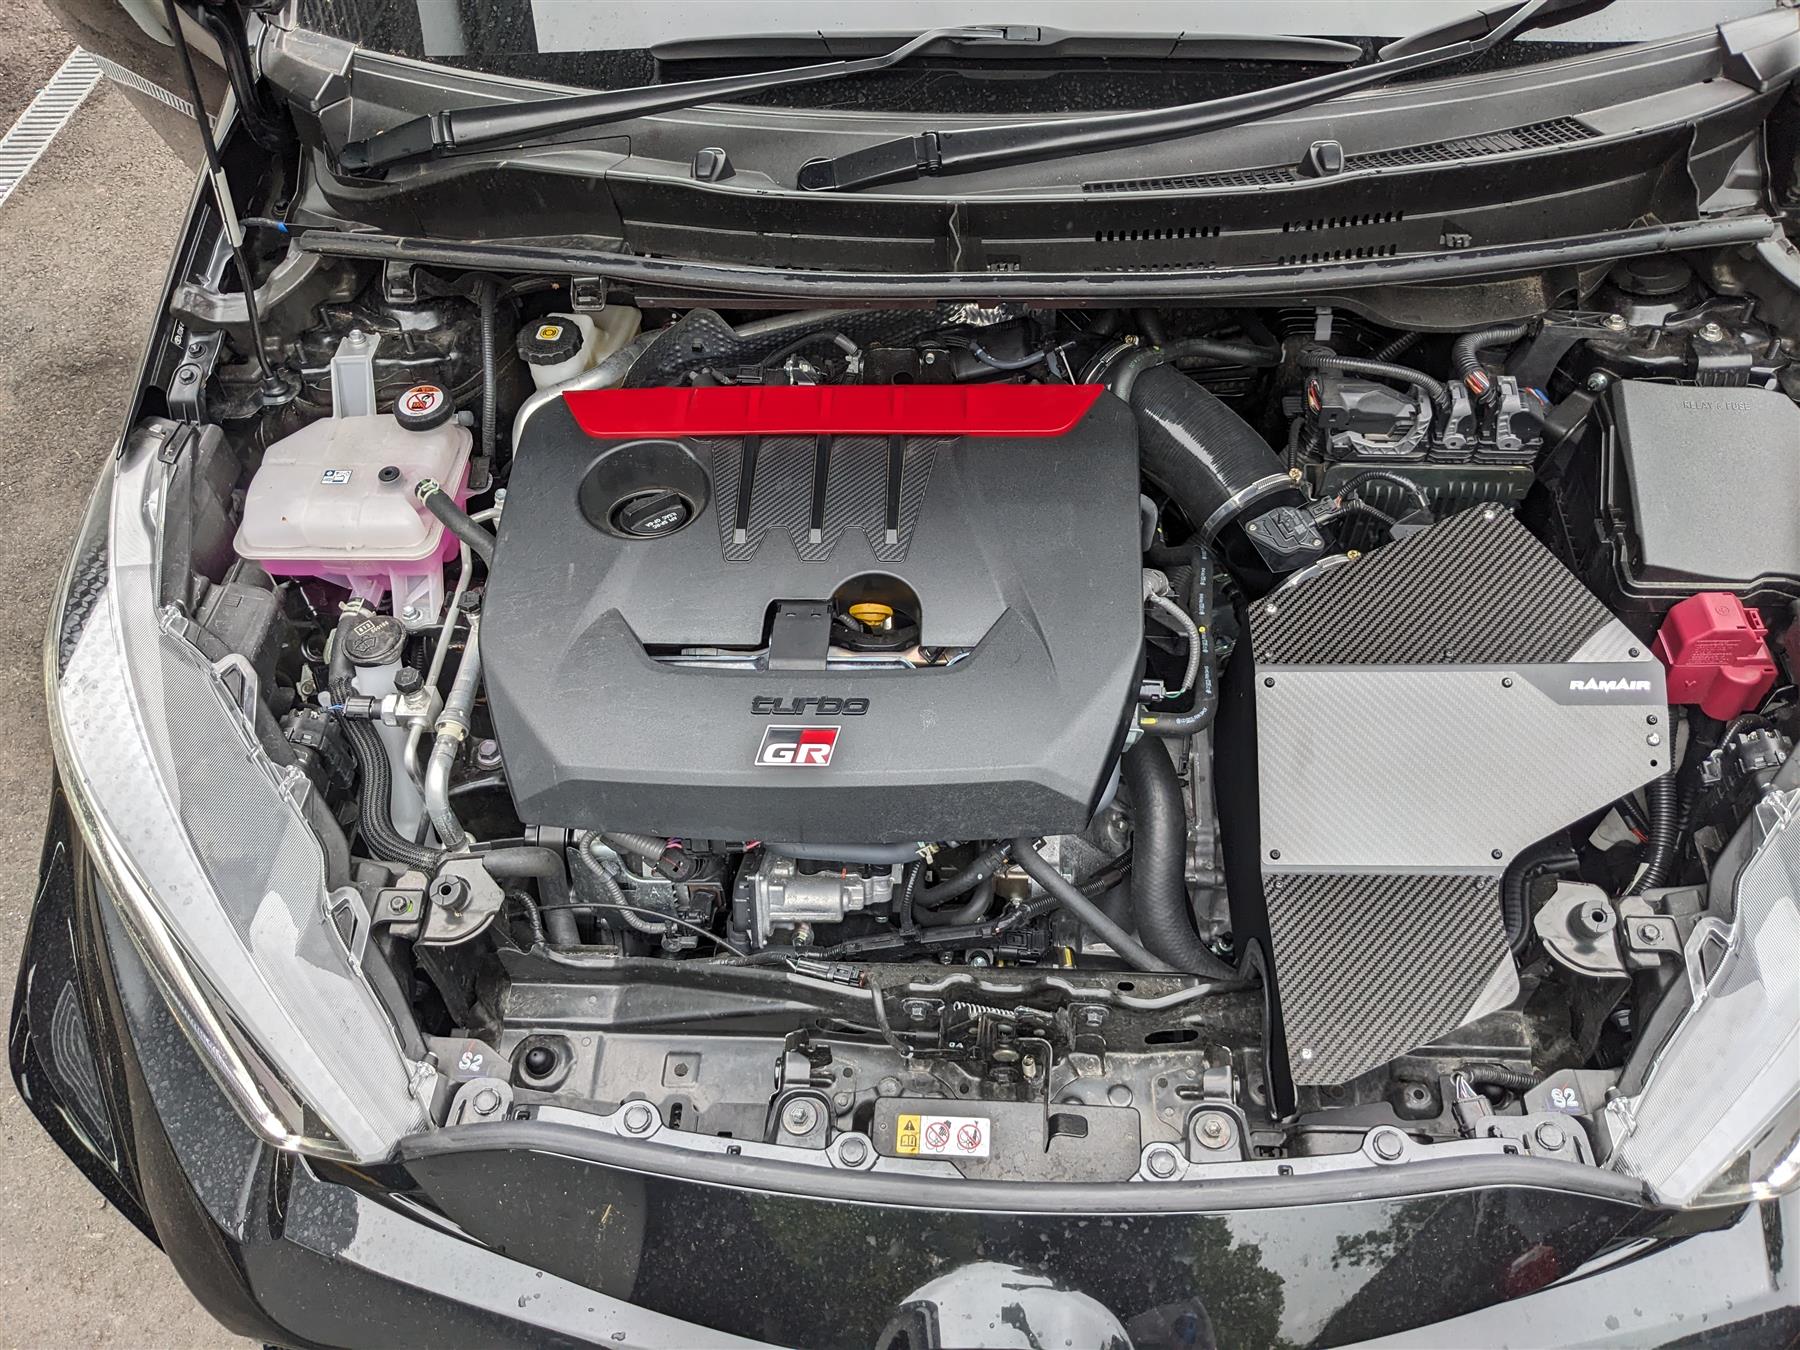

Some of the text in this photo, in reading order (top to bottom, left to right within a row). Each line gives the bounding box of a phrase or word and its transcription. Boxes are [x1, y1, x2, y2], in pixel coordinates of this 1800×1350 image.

[1725, 401, 1752, 411] FUSE
[1569, 677, 1651, 693] RAMAIR
[750, 695, 870, 715] turbo
[762, 743, 831, 763] GR
[458, 1051, 483, 1072] S2
